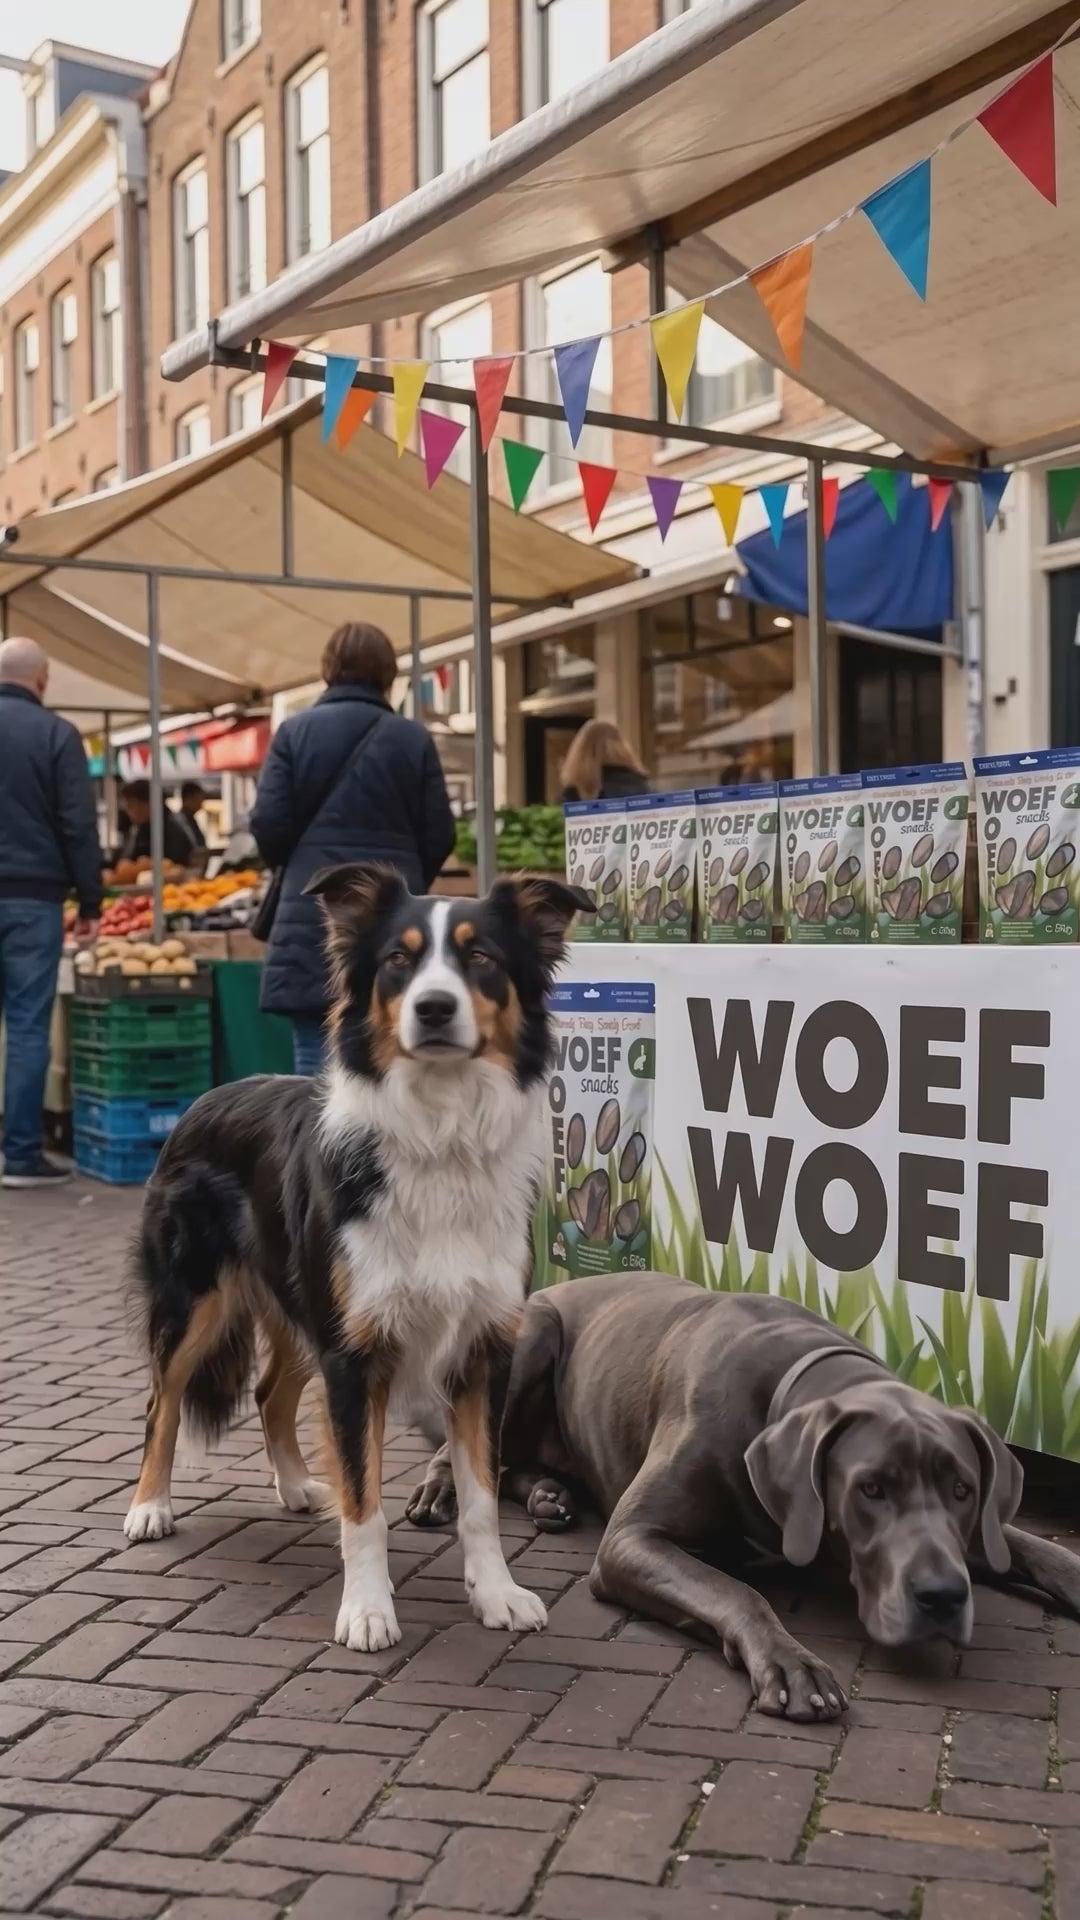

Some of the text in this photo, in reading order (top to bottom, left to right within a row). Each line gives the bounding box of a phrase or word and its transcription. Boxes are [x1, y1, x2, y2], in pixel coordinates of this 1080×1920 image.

[867, 798, 939, 824] WOEF
[981, 786, 1056, 815] WOEF
[630, 818, 679, 841] WOEF
[701, 813, 755, 837] WOEF
[784, 806, 844, 831] WOEF
[568, 825, 611, 846] WOEF
[686, 997, 1051, 1145] WOEF
[581, 1074, 619, 1095] snacks
[686, 1125, 1049, 1302] WOEF
